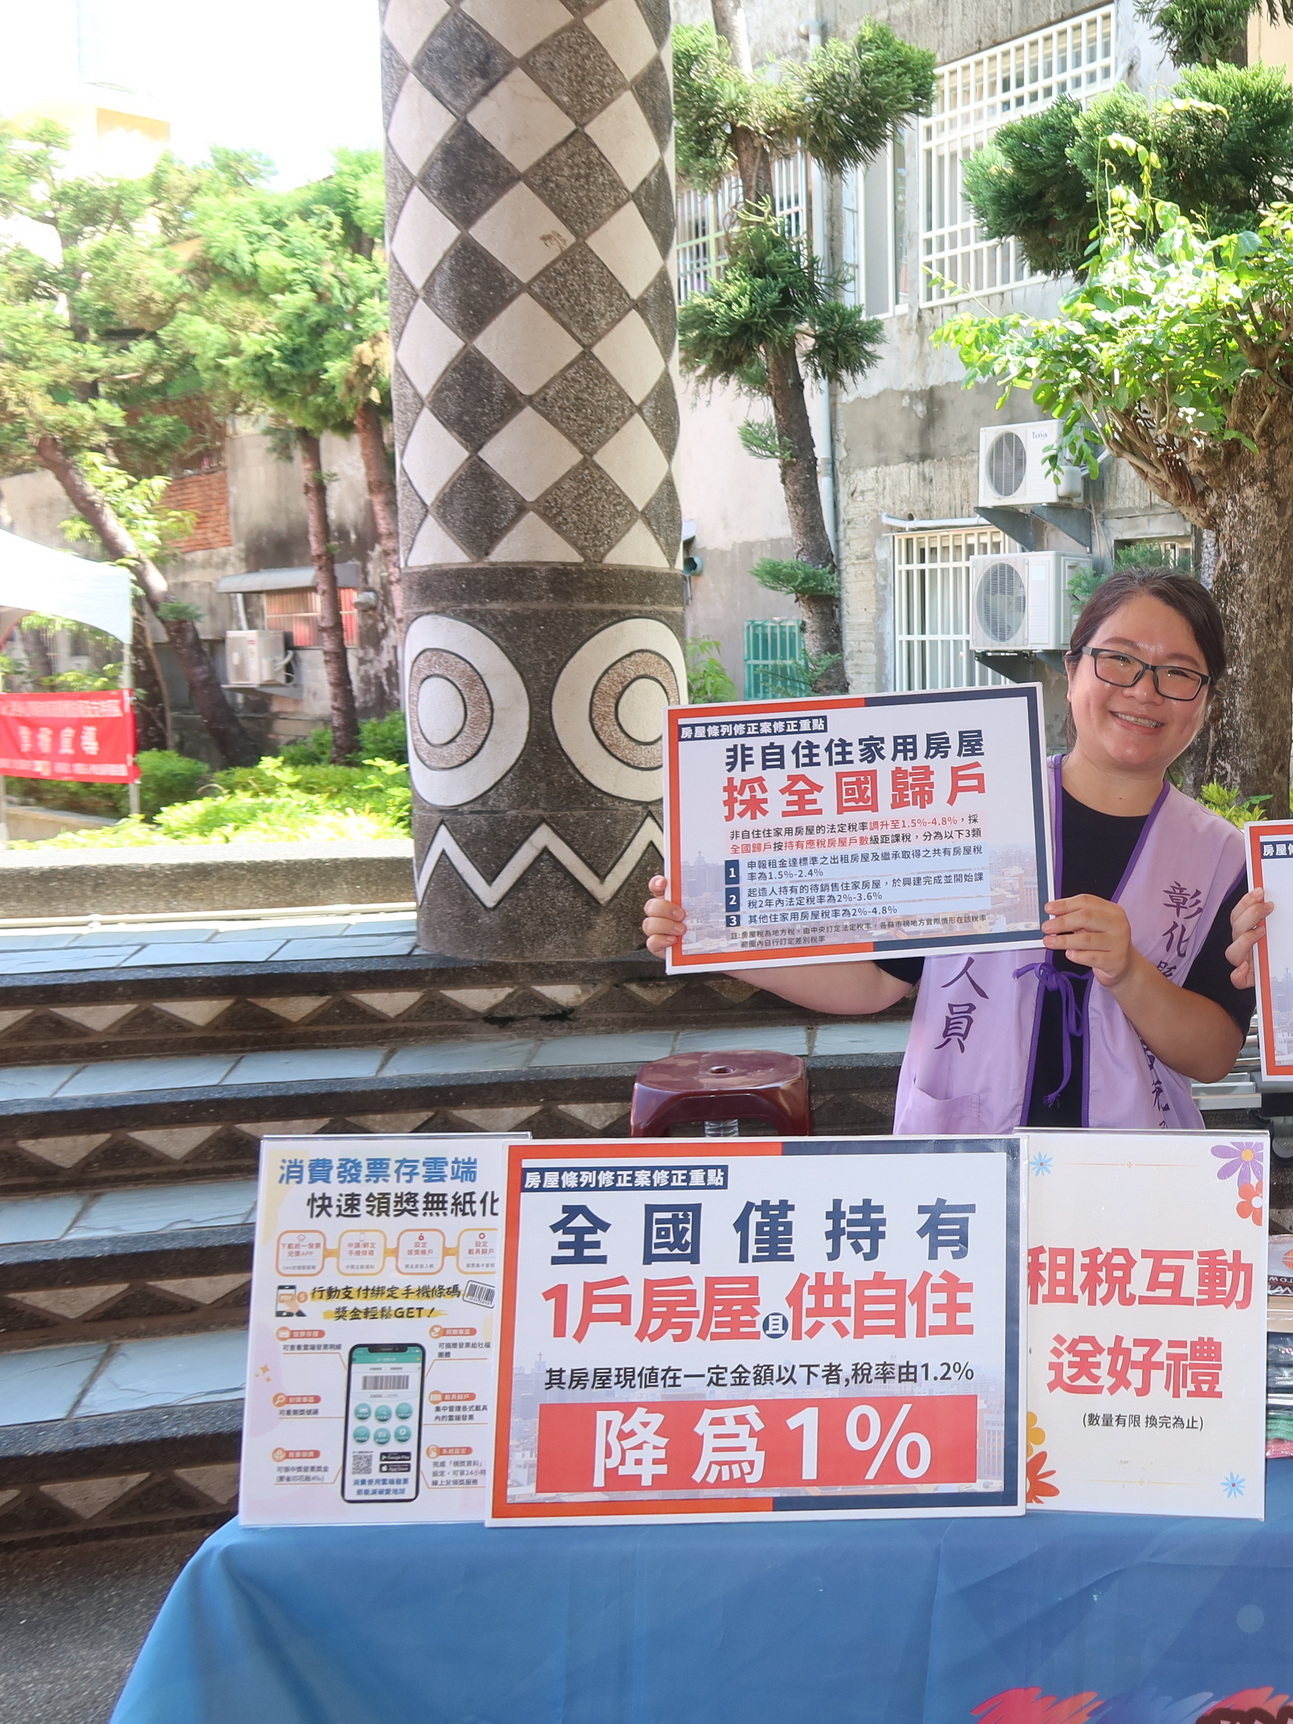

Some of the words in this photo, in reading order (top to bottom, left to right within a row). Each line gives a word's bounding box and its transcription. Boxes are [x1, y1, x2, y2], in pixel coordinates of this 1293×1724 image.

[681, 718, 825, 739] 房屋條列修正案修正重點
[725, 730, 984, 772] 非自住住家用房屋
[723, 762, 986, 822] 採全國歸戶
[729, 867, 736, 878] 1
[729, 895, 737, 905] 2
[729, 916, 737, 925] 3
[278, 1157, 477, 1184] 消費發票存雲端
[523, 1169, 724, 1189] 房屋條列修正案修正重點
[550, 1198, 977, 1266] 全國僅持有
[1028, 1245, 1253, 1310] 租稅互動
[310, 1284, 461, 1300] 行動支付綁定手機條碼
[1047, 1333, 1223, 1398] 送好禮
